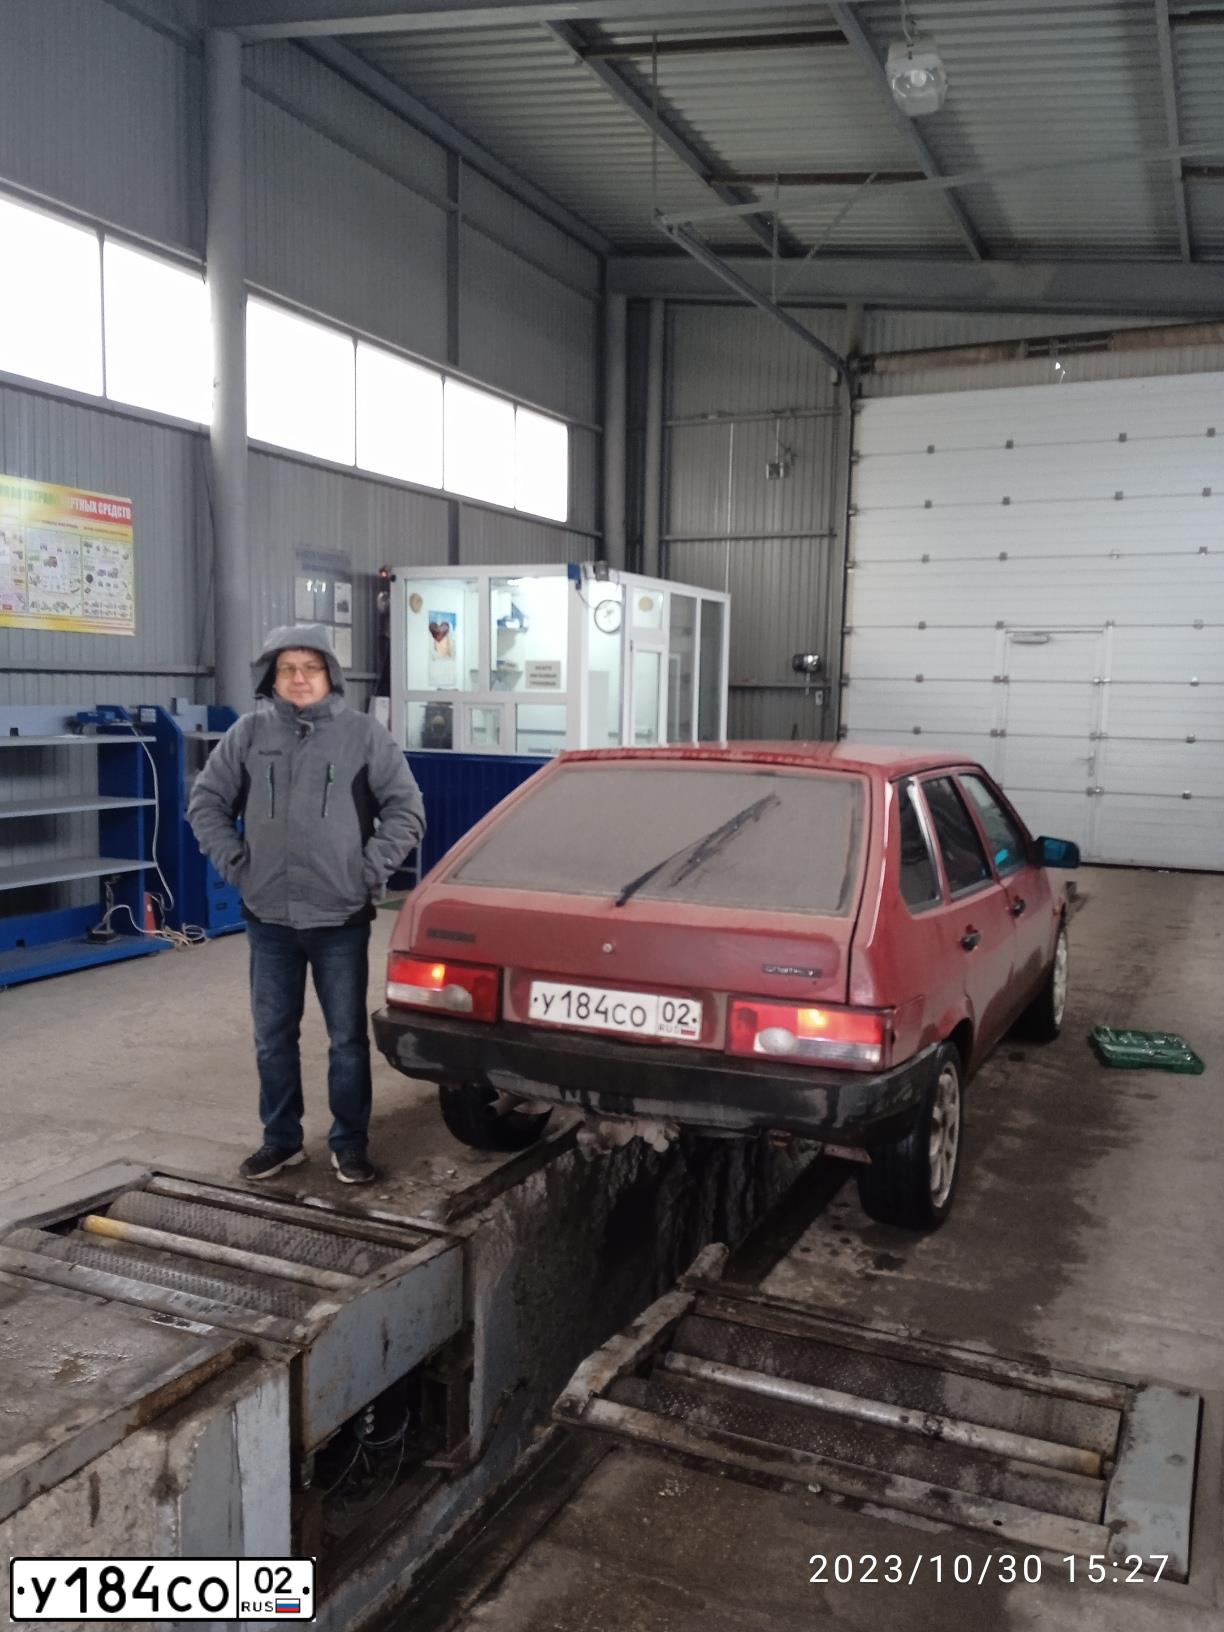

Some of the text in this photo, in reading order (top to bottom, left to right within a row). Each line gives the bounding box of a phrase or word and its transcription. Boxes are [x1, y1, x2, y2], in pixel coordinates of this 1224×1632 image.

[98, 502, 131, 520] СРЕДСТВ
[542, 990, 647, 1028] У184СО
[662, 1001, 691, 1026] 02
[658, 1025, 680, 1035] RUS
